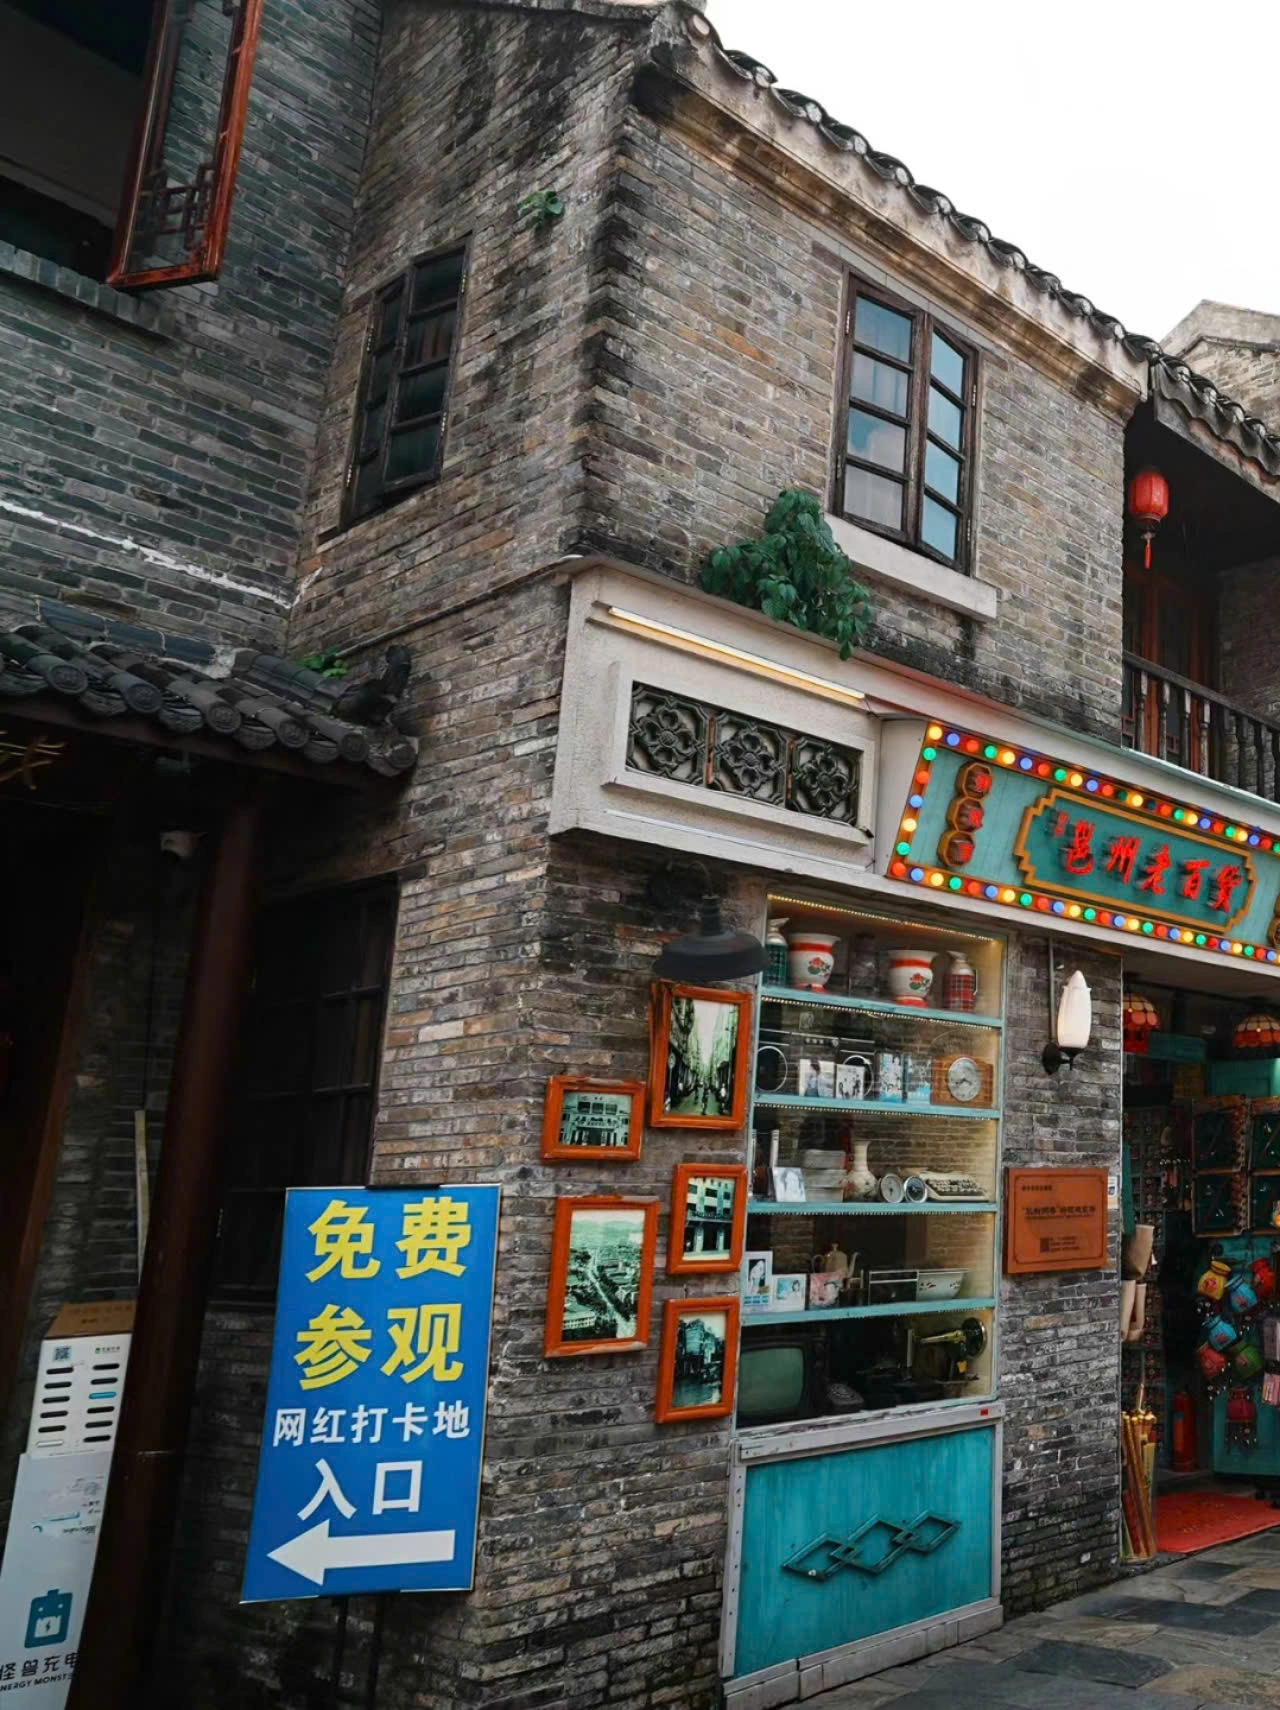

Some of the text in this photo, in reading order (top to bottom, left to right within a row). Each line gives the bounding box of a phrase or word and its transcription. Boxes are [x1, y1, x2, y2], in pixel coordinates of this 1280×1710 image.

[1066, 819, 1242, 913] 邕州老百货
[306, 1196, 472, 1283] 免费
[293, 1303, 464, 1390] 参观
[272, 1399, 471, 1448] 网红打卡地
[296, 1459, 424, 1521] 入口
[0, 1679, 32, 1691] NERGY
